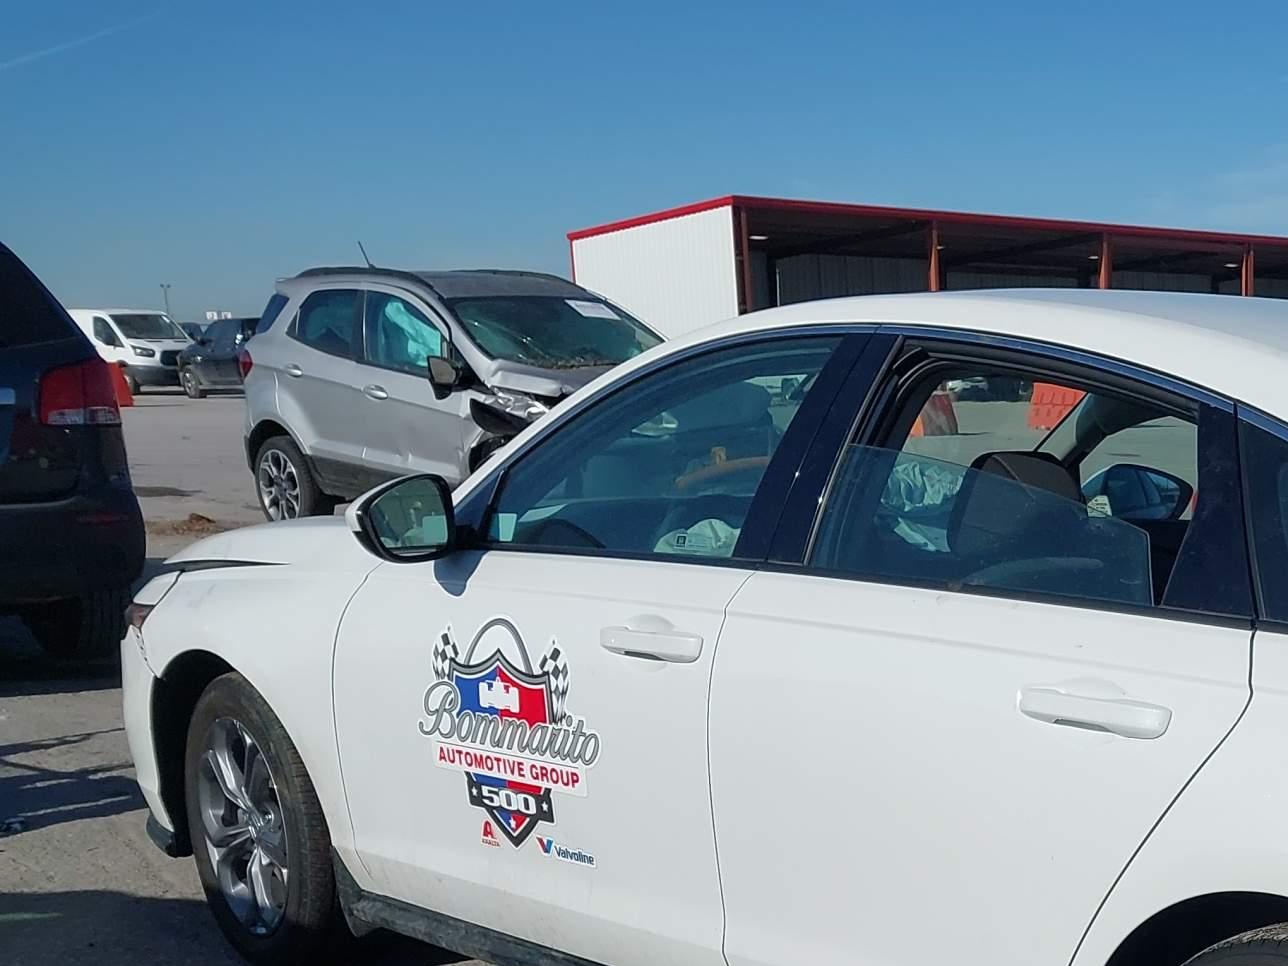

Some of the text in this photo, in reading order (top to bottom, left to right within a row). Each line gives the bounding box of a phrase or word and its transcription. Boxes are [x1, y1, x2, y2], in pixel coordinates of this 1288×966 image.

[419, 681, 600, 766] Bommarito
[439, 746, 580, 788] AUTOMOTIVE GROUP
[482, 785, 537, 815] 500
[554, 845, 595, 866] Valvoline
